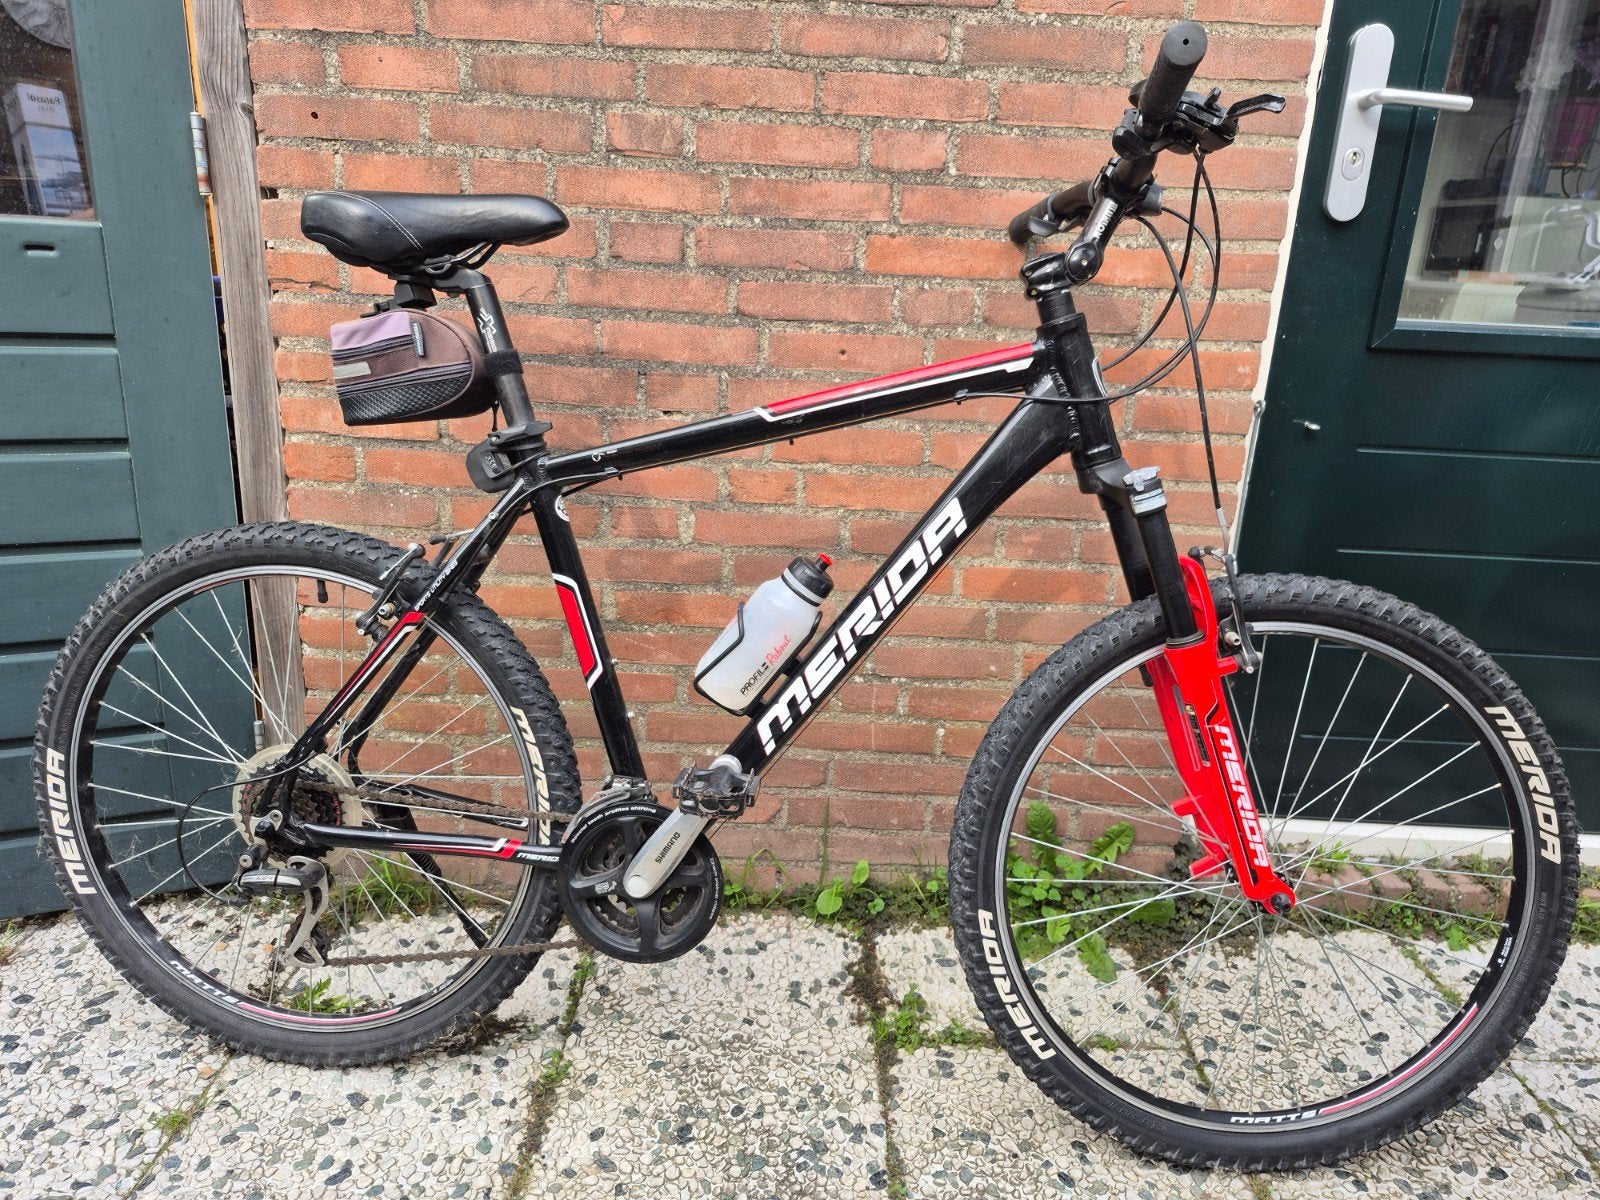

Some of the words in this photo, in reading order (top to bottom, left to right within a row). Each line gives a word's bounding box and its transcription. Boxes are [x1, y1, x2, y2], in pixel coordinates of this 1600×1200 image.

[756, 497, 968, 757] MERIDA
[46, 747, 98, 895] MERIDA
[516, 851, 560, 863] MERID
[654, 831, 681, 864] SHIMANO
[1213, 724, 1270, 868] MERIDA
[1484, 705, 1562, 865] MERIDA
[169, 960, 240, 1004] MATTS
[977, 908, 1057, 1061] MERIDA
[1229, 1109, 1318, 1124] MATTS
